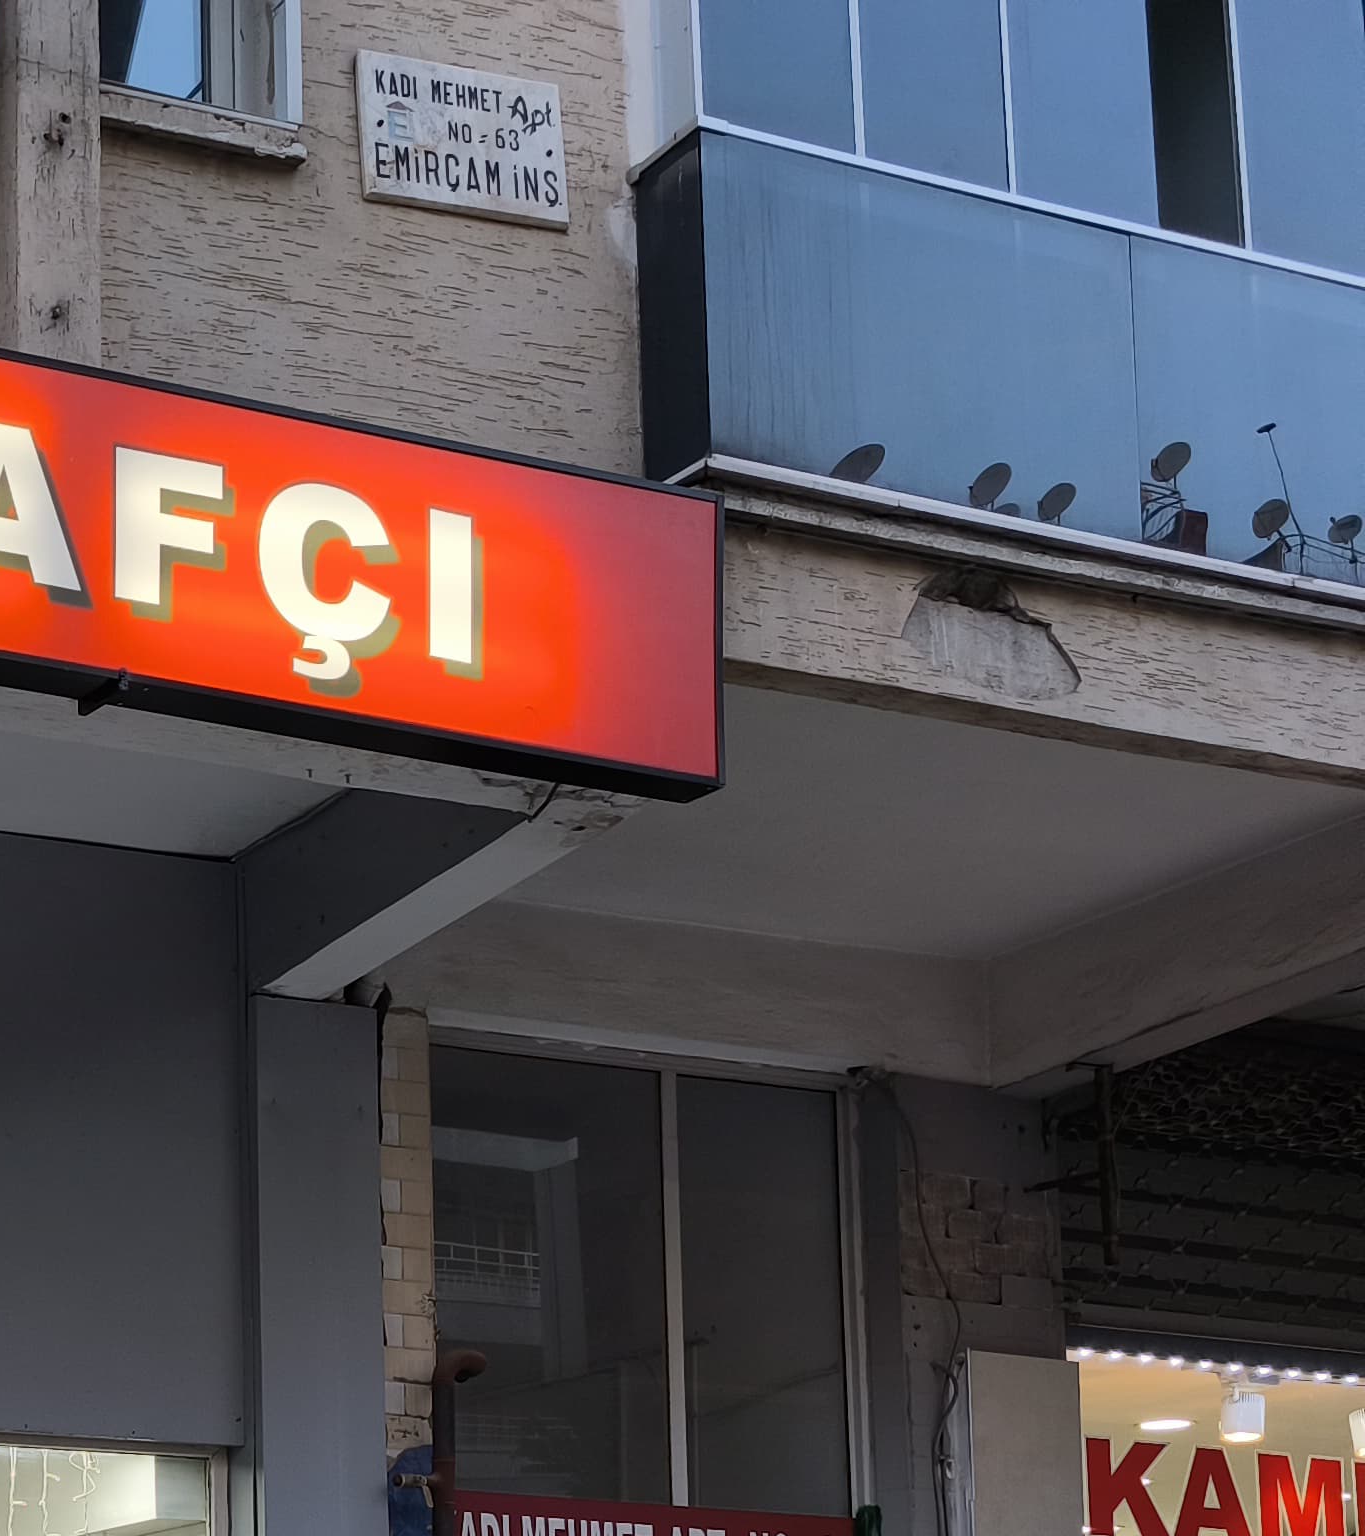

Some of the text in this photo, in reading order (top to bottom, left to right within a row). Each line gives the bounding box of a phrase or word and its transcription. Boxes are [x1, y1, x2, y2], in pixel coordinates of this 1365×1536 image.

[375, 69, 418, 101] KADI
[431, 79, 503, 115] MEHMET
[495, 128, 520, 152] 63
[375, 141, 502, 197] EMİRÇAM
